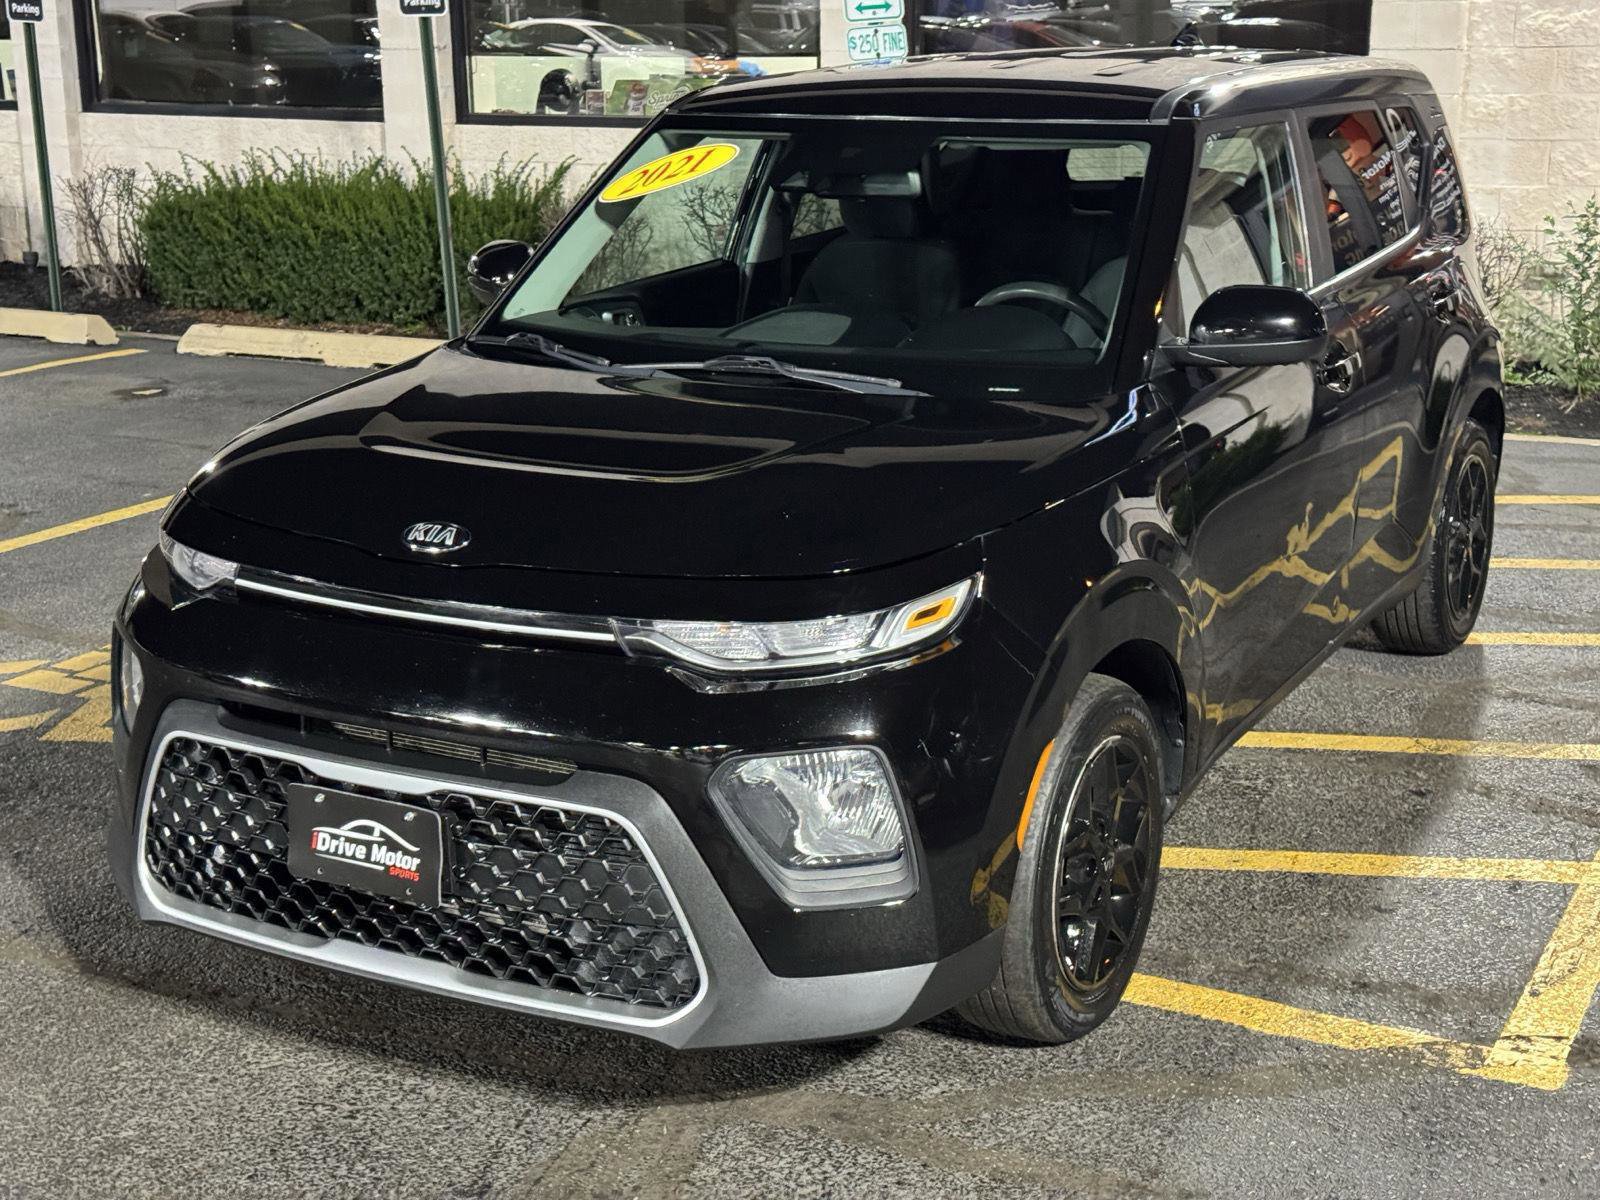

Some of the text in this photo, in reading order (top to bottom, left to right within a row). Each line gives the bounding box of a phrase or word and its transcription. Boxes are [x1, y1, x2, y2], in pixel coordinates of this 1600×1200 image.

[11, 2, 40, 17] Parking
[883, 31, 905, 51] FINE
[617, 148, 707, 197] 2021
[407, 523, 457, 546] KIA
[310, 830, 421, 872] iDrive Motor
[388, 865, 420, 882] SPORTS
